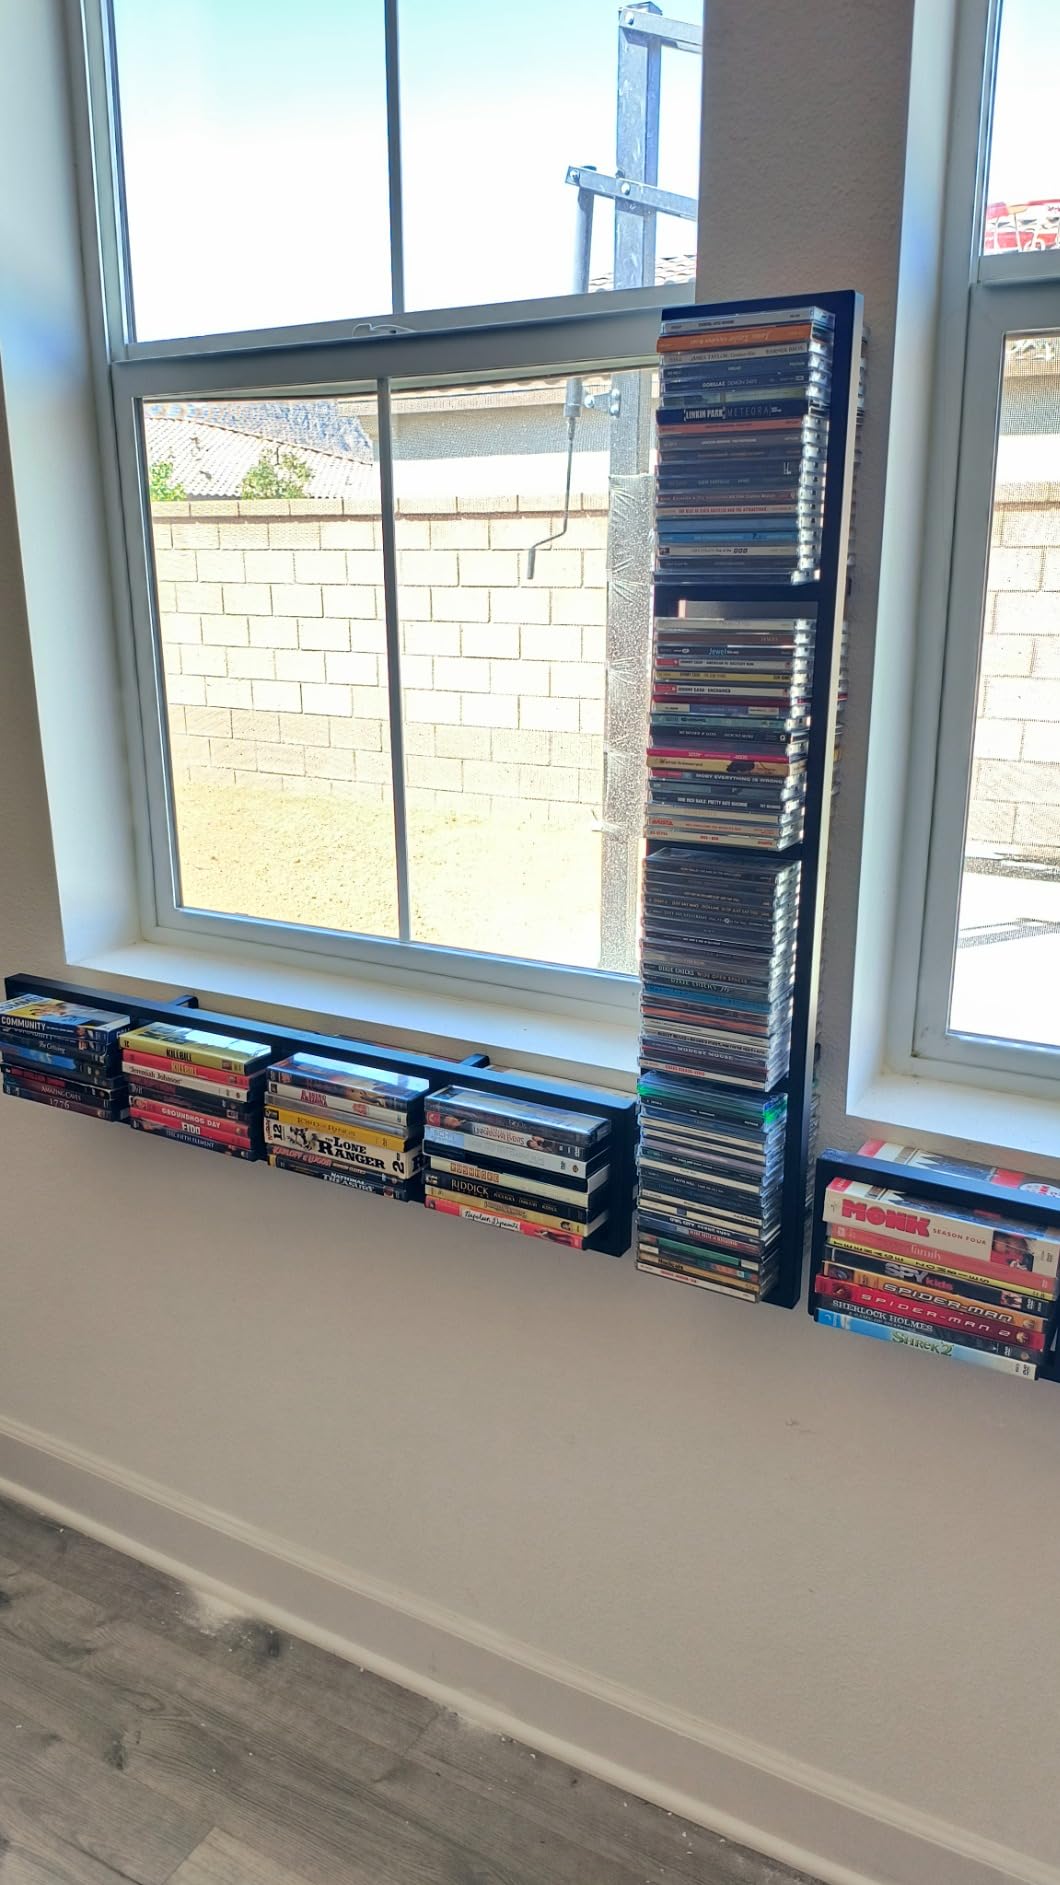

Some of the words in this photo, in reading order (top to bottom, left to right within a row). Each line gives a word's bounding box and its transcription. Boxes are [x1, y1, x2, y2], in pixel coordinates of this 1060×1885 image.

[1, 1016, 46, 1031] COMMUNITY
[50, 1098, 70, 1109] 1776
[161, 1108, 205, 1125] GROUNDHOG
[207, 1119, 221, 1129] DAY
[181, 1122, 201, 1135] FIDO
[273, 1124, 282, 1141] 12
[332, 1136, 367, 1154] LONE
[317, 1140, 386, 1170] RANGER
[452, 1179, 489, 1195] RIDDICK
[842, 1199, 931, 1238] MONK
[933, 1228, 963, 1240] SEASON
[965, 1236, 987, 1246] FOUR
[885, 1262, 929, 1284] SPY
[883, 1283, 1014, 1323] SPIDER-MAN
[832, 1299, 887, 1321] SHERLOCK
[889, 1314, 934, 1333] HOLMES
[860, 1293, 991, 1333] SPIDER-MAN
[998, 1329, 1011, 1338] 2
[940, 1344, 954, 1357] 2
